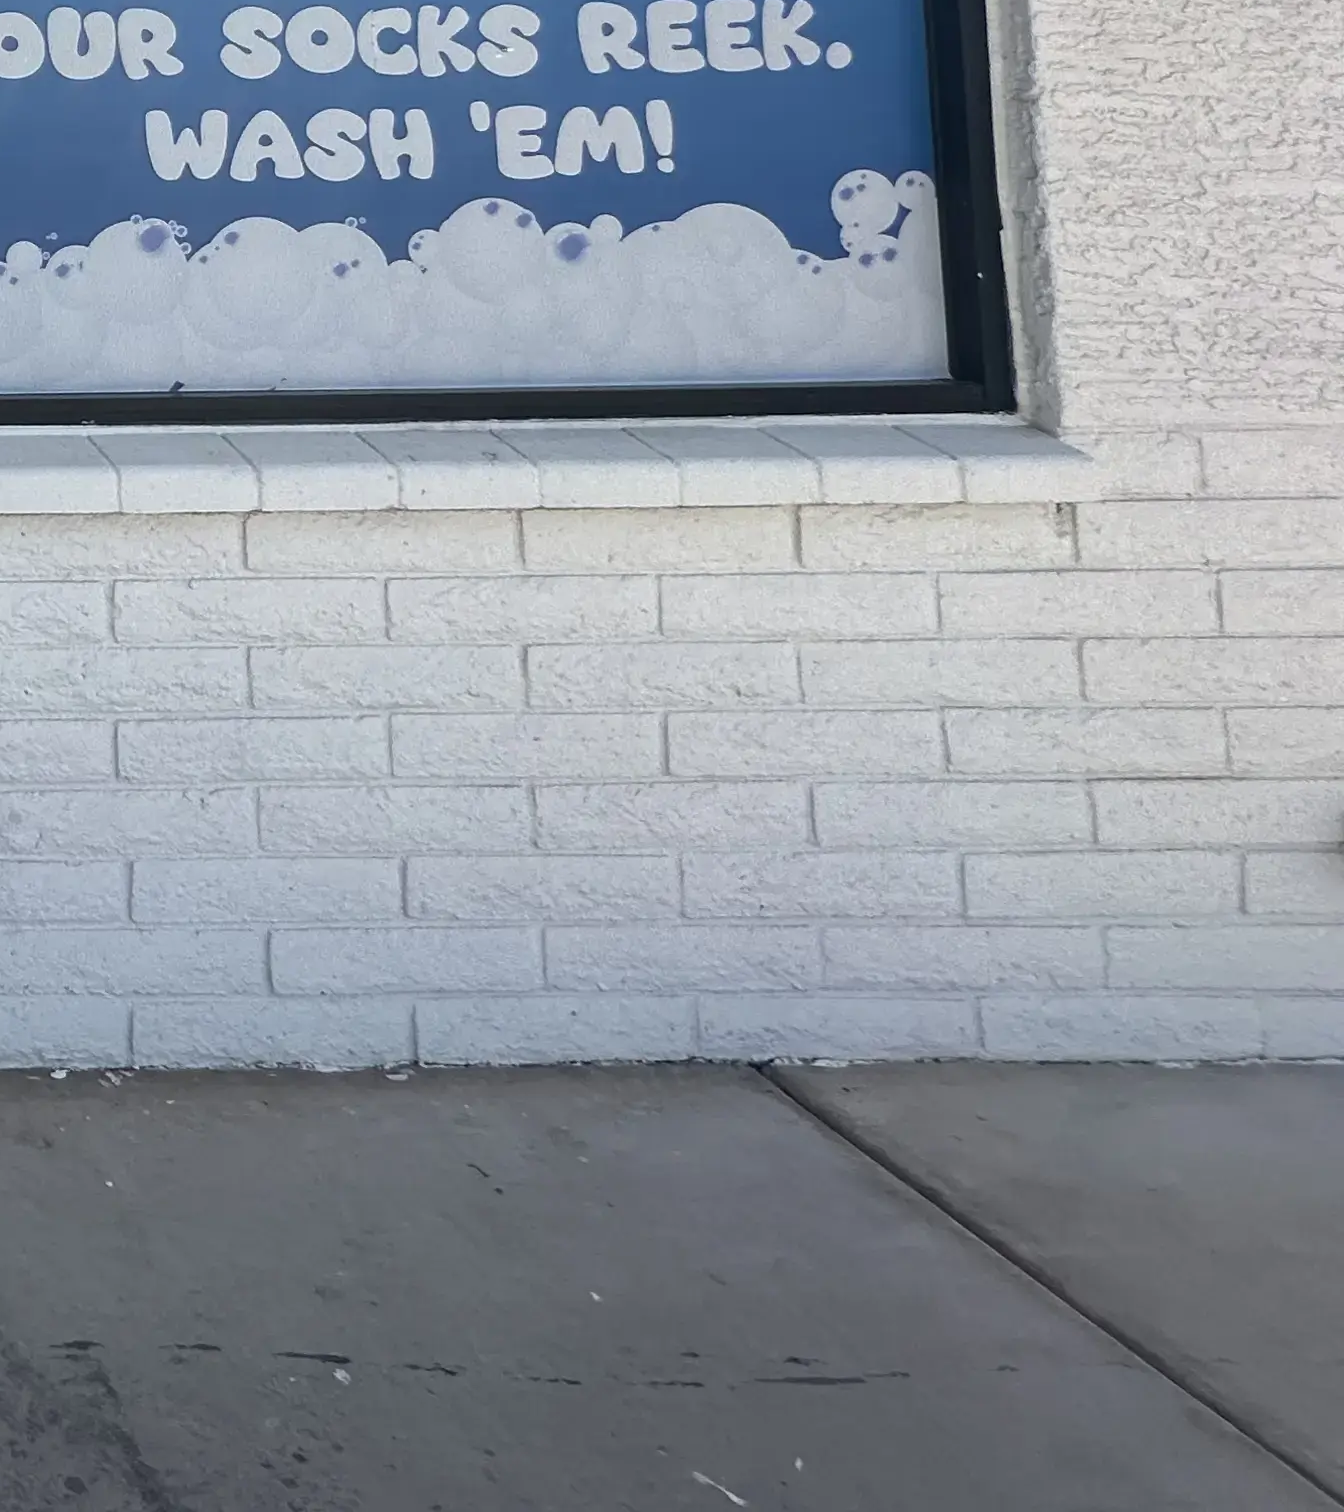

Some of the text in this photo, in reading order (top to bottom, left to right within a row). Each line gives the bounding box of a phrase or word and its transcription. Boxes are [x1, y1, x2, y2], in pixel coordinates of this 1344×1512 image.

[220, 5, 541, 80] SOCKS
[145, 99, 675, 182] WASH 'EM!
